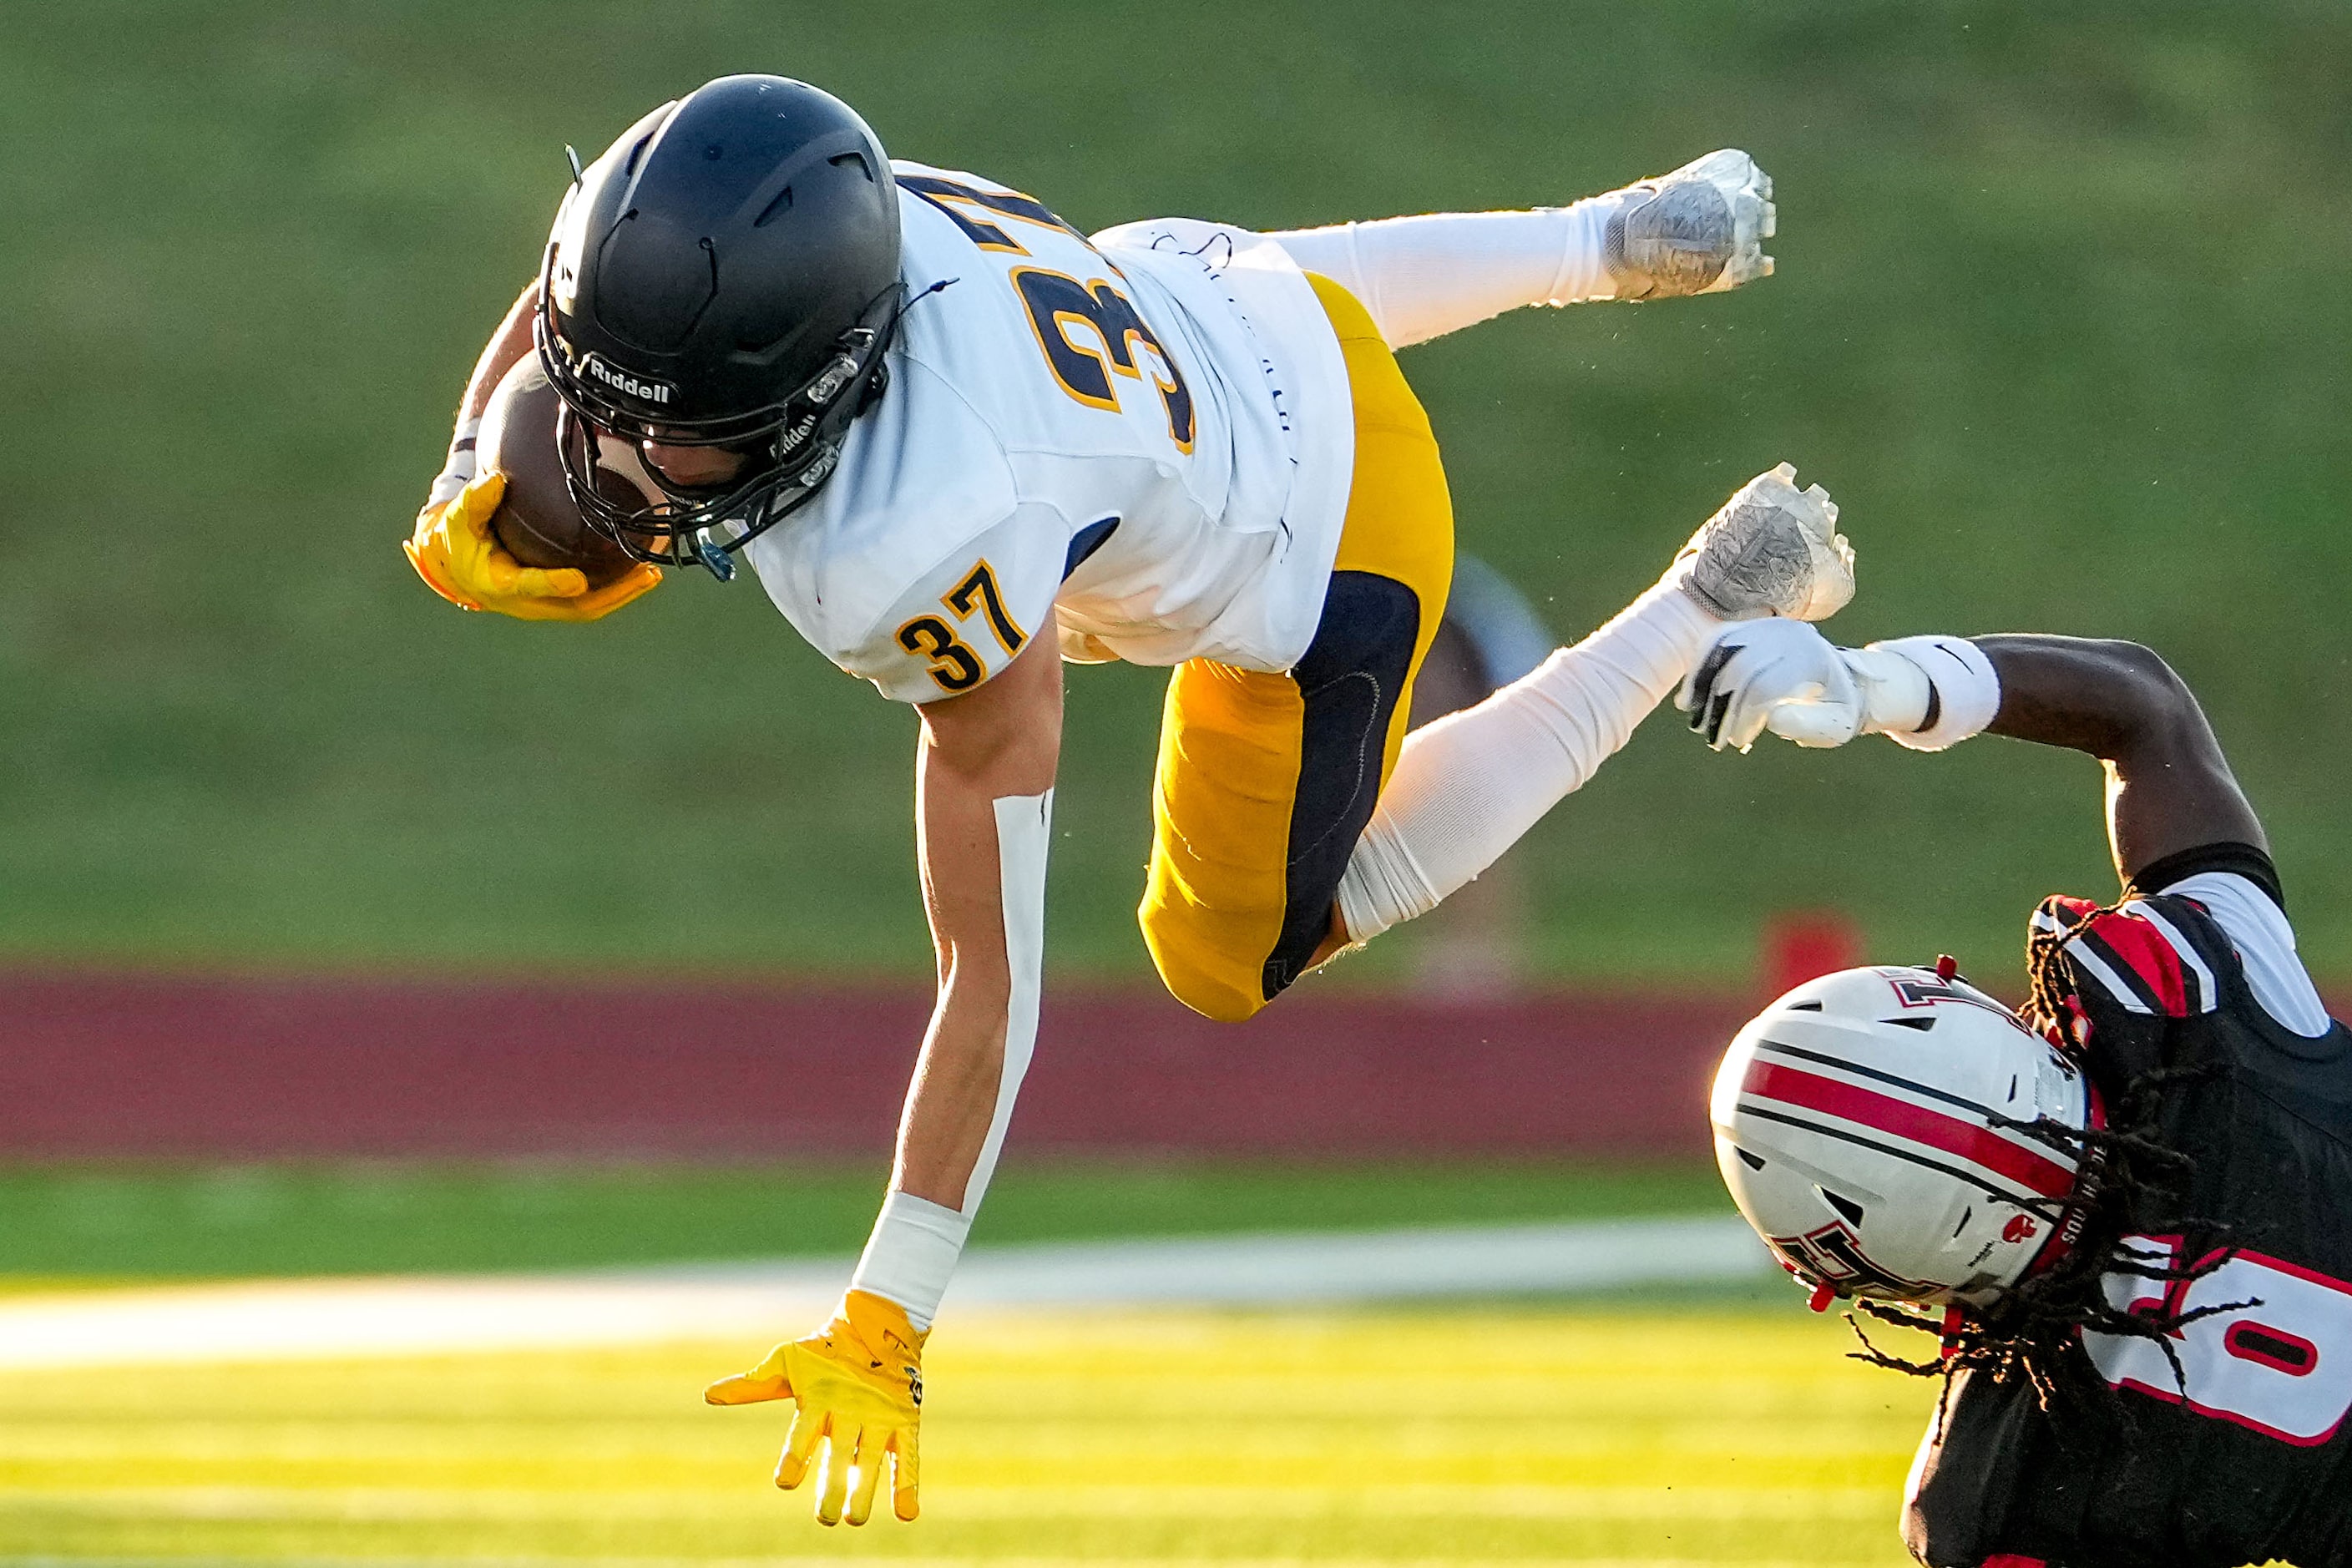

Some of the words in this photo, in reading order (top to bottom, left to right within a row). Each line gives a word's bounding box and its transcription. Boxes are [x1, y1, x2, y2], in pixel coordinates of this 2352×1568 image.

[590, 358, 669, 404] Riddell
[893, 174, 1196, 455] 37
[769, 414, 816, 461] ddell
[895, 557, 1029, 695] 37
[2072, 1233, 2352, 1448] 6
